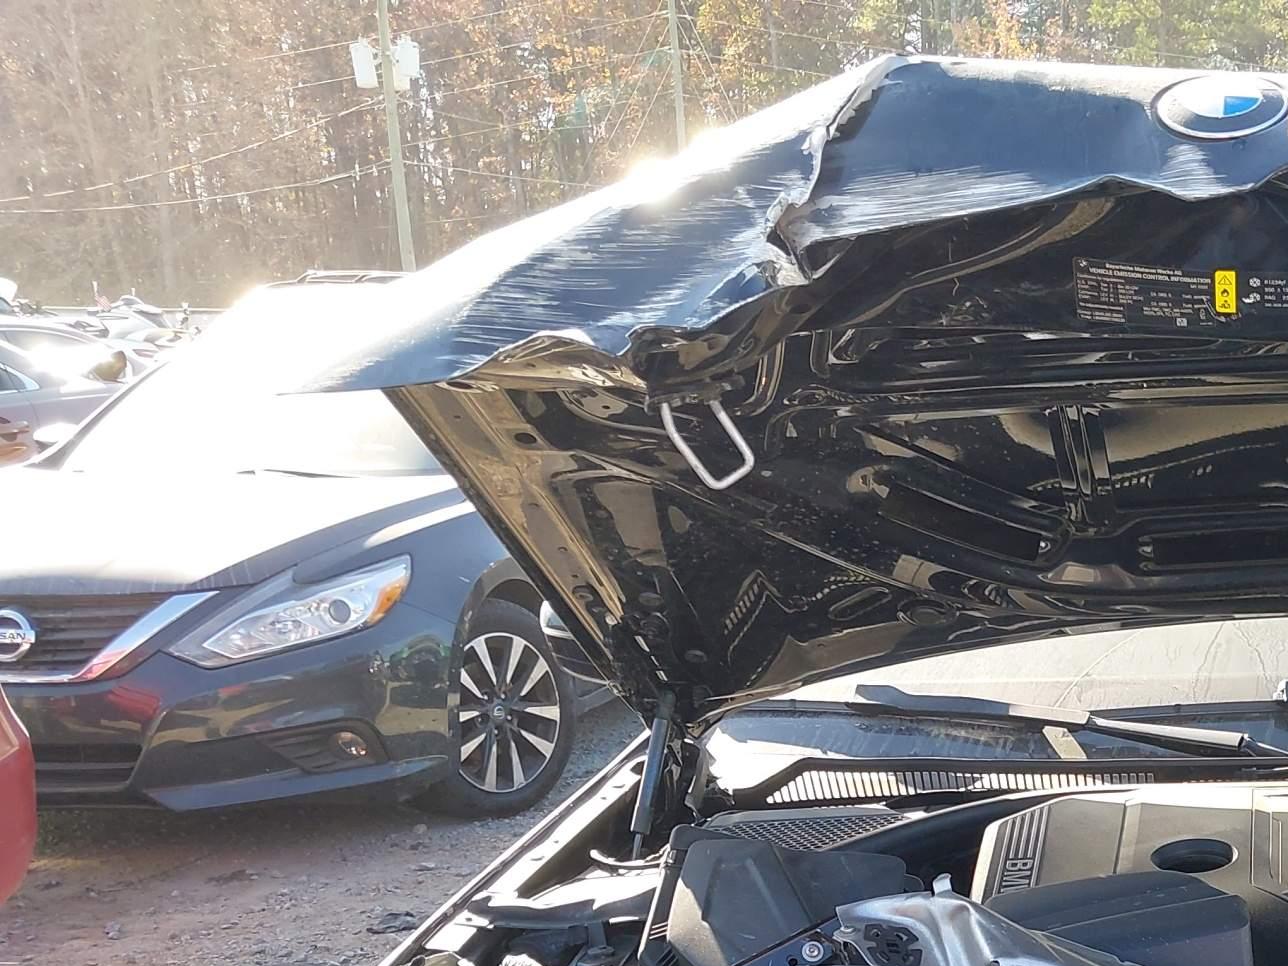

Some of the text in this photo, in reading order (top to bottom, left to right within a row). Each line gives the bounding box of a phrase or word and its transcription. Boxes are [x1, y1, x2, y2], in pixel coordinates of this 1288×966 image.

[1089, 267, 1113, 276] VEHICLE
[1113, 269, 1142, 279] EMISSION
[1142, 273, 1170, 281] CONTROL
[1170, 276, 1211, 284] INFORMATION
[0, 632, 25, 640] SAN
